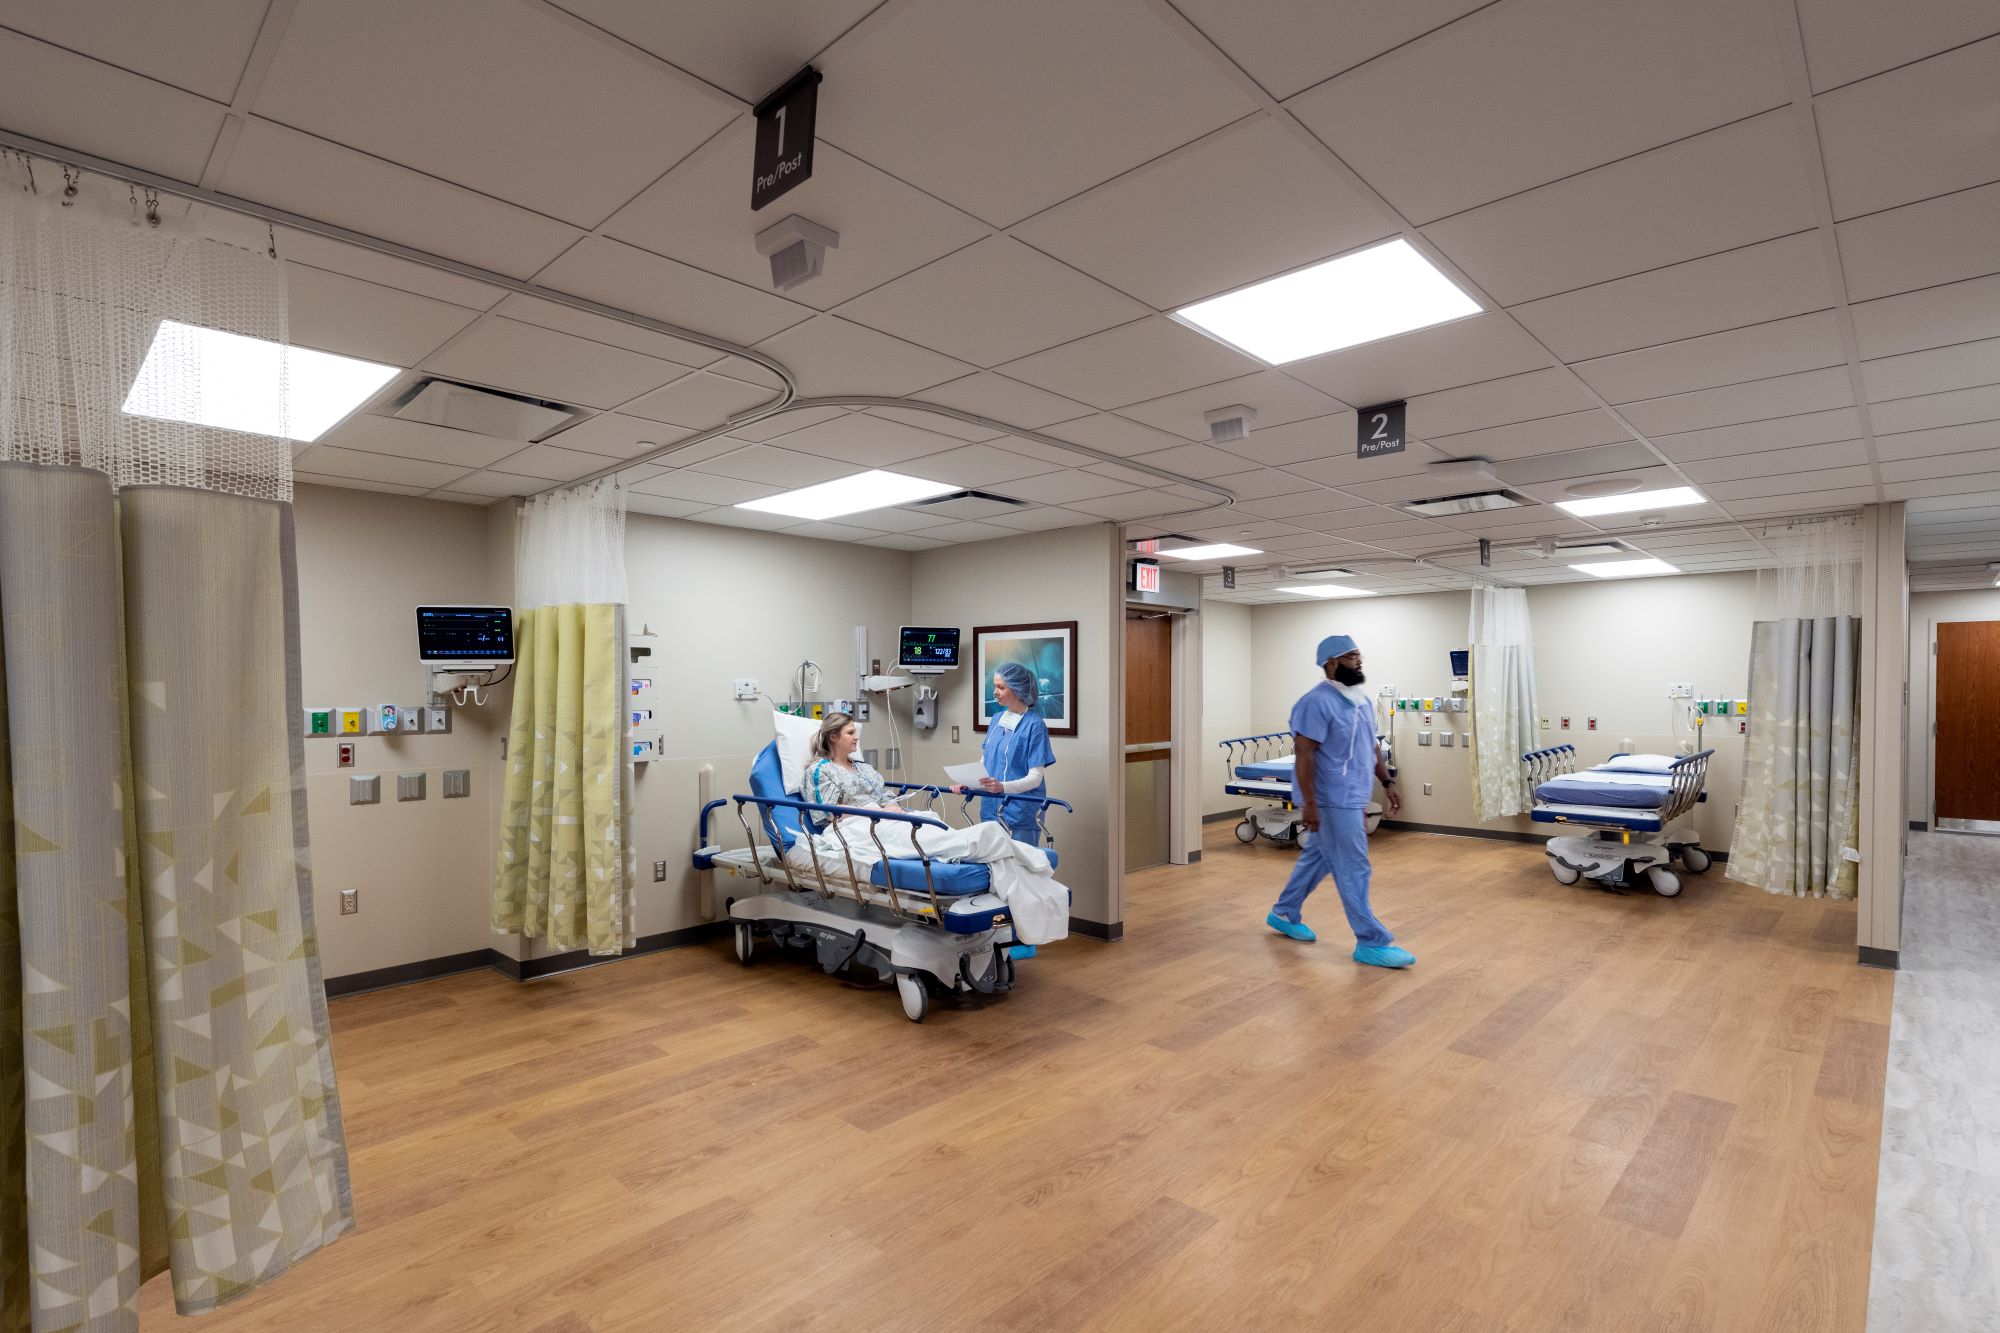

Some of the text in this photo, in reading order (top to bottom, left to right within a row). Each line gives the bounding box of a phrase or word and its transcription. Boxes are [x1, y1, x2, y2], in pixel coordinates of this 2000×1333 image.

[775, 105, 786, 157] 1
[757, 151, 803, 193] Pre/Post
[1371, 413, 1388, 440] 2
[1361, 438, 1399, 452] Pre/Post
[1140, 566, 1158, 591] EXIT
[1227, 570, 1232, 581] 3
[927, 634, 936, 643] 77
[914, 646, 922, 655] 18
